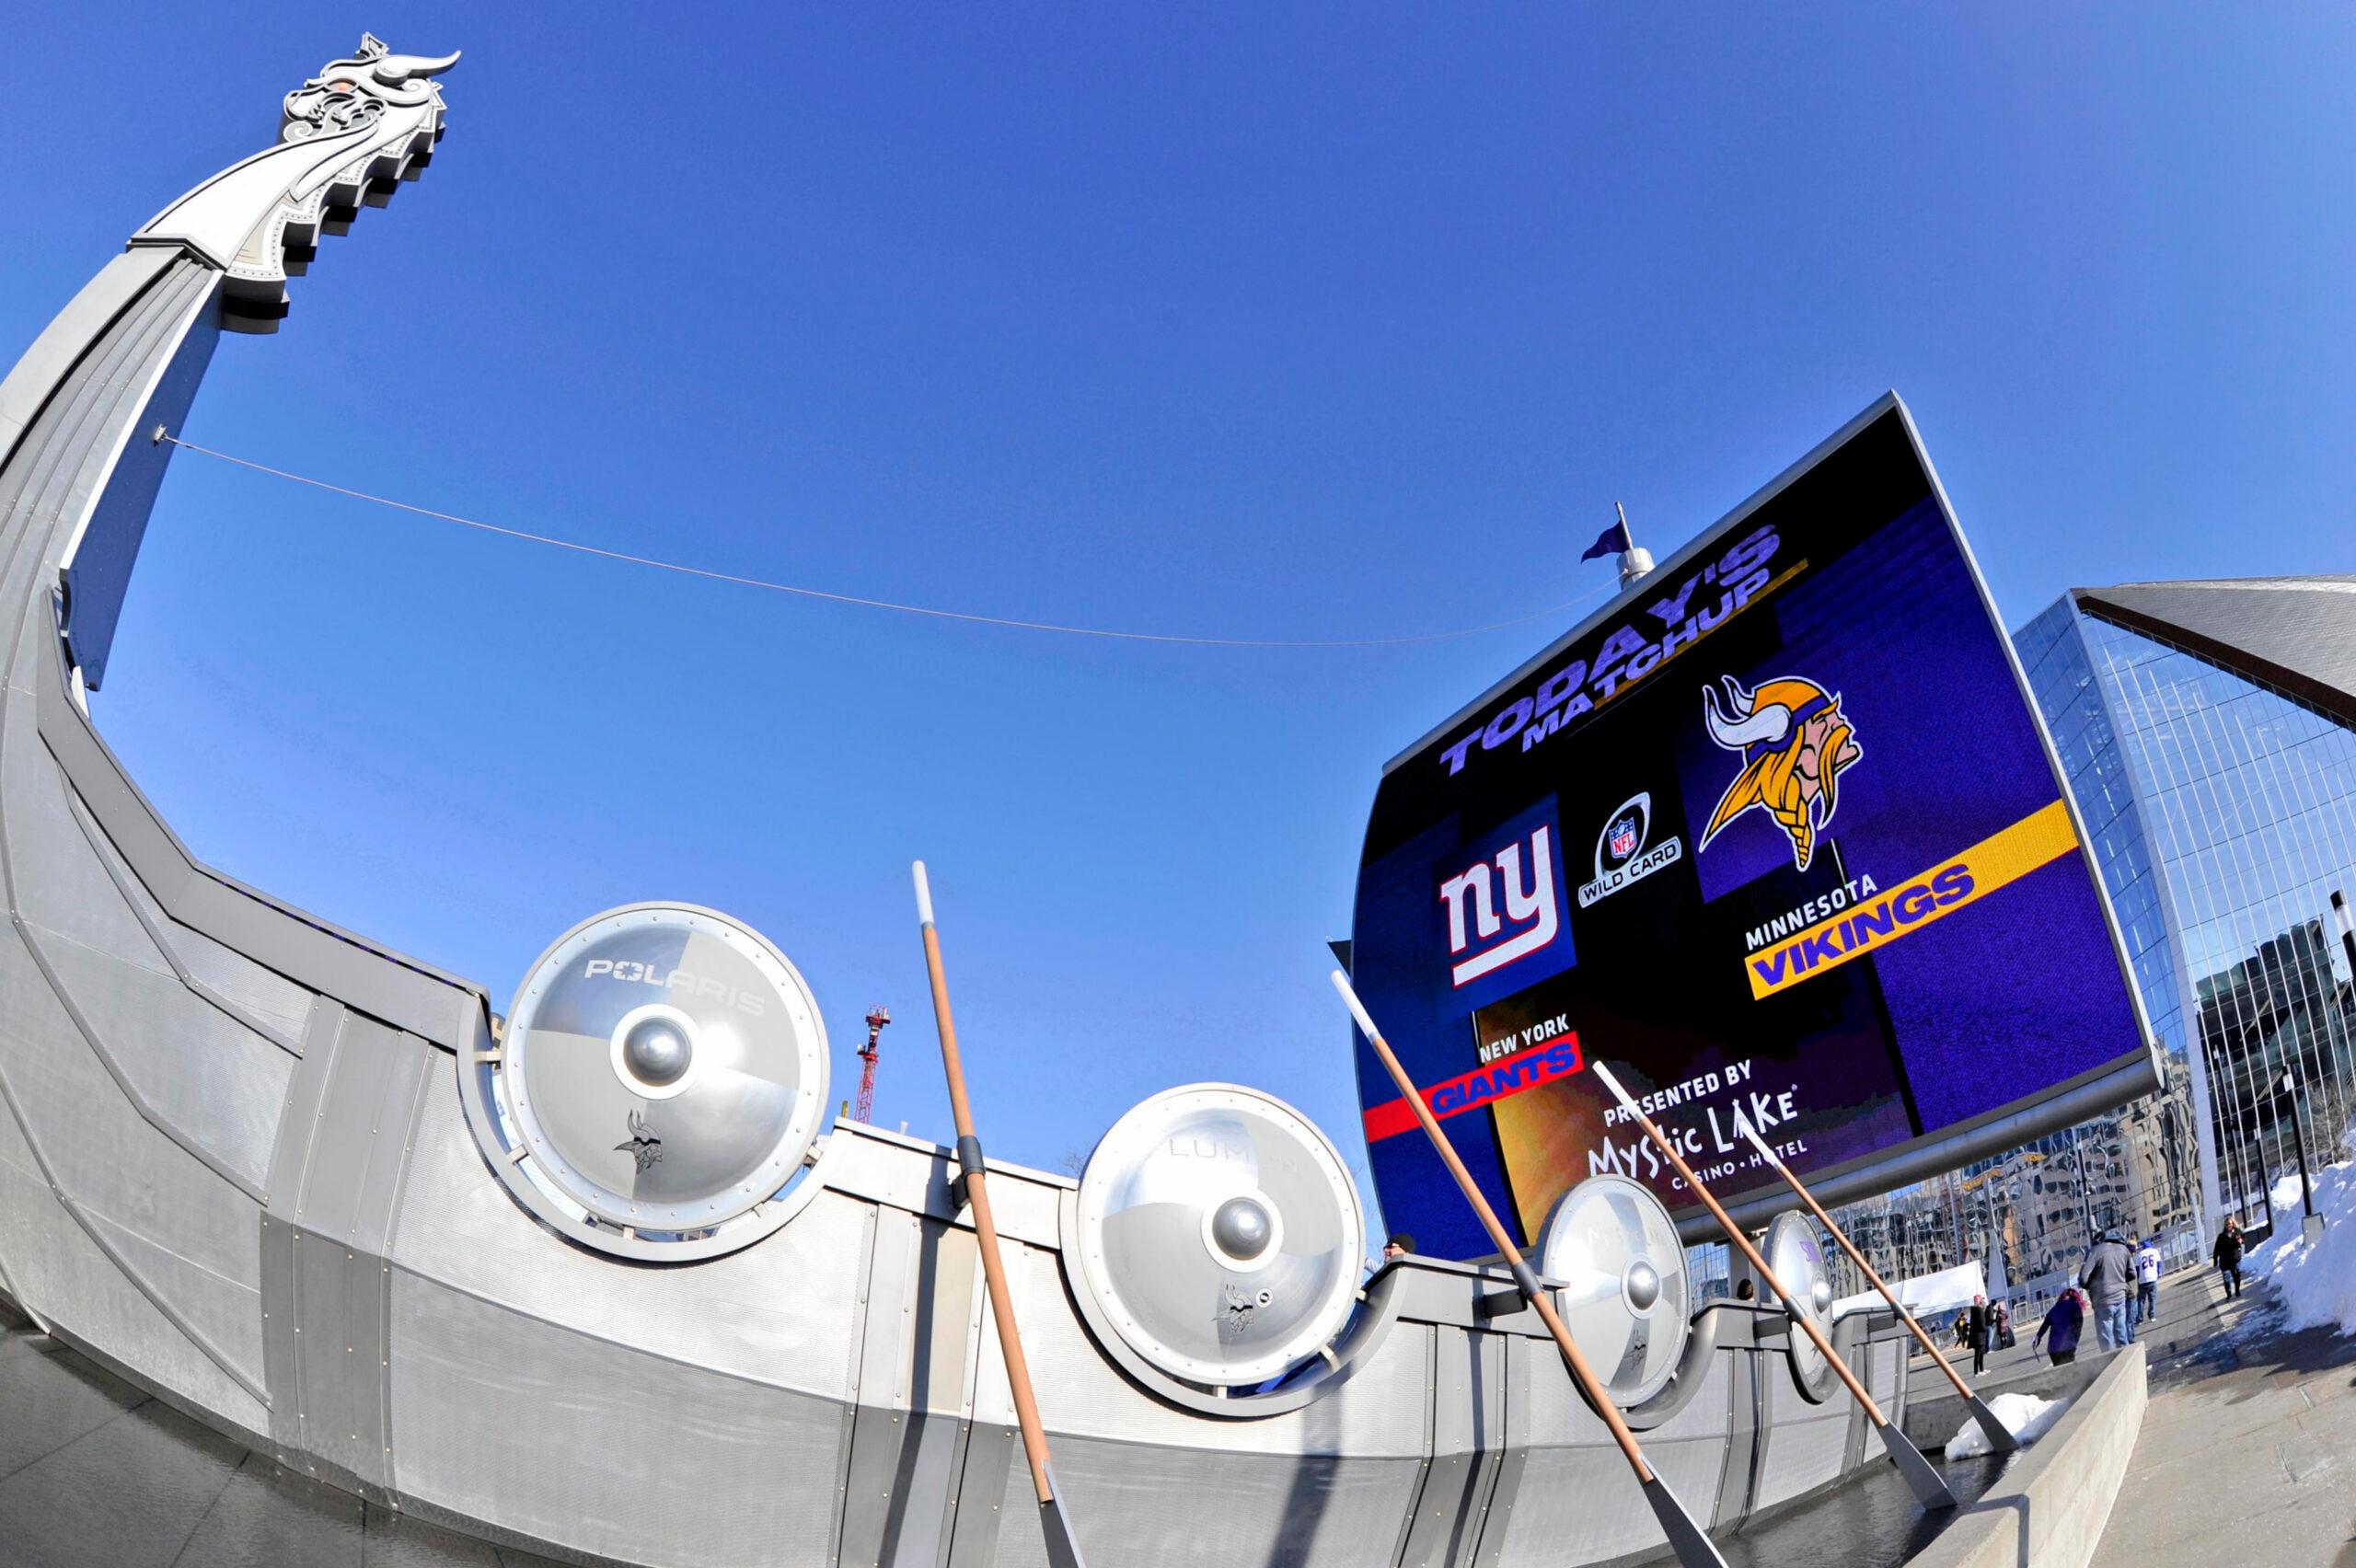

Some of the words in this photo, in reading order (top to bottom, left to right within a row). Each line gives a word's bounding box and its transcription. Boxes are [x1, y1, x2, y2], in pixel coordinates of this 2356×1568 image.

[1439, 523, 1781, 778] TODAY'S
[1521, 567, 1771, 753] MATCHUP
[1583, 871, 1624, 902] WILD
[1630, 843, 1678, 878] CARD
[1612, 831, 1635, 859] NFL
[1745, 873, 1878, 951] MINNESOTA
[1751, 863, 1976, 987] VIKINGS
[583, 958, 767, 1018] POLARIS
[1479, 1033, 1518, 1064] NEW
[1521, 1013, 1570, 1046] YORK
[1431, 1043, 1576, 1115] GIANTS
[1725, 1058, 1752, 1087] BY
[1671, 1160, 1736, 1191] CSINO
[1750, 1139, 1808, 1169] HTEL
[2142, 1253, 2154, 1271] 26
